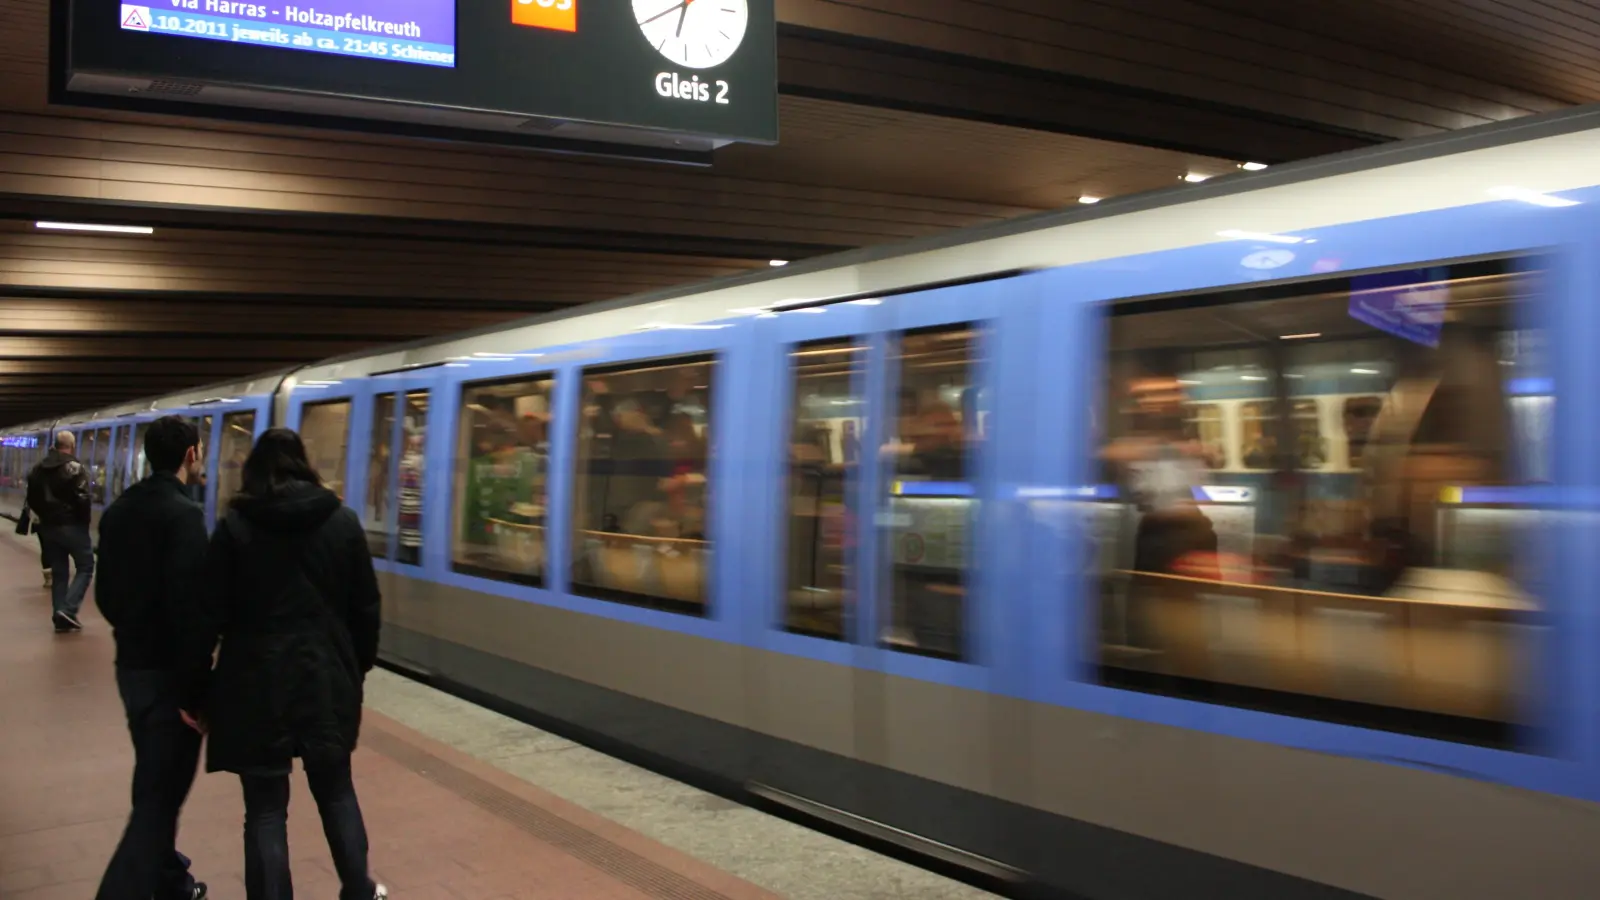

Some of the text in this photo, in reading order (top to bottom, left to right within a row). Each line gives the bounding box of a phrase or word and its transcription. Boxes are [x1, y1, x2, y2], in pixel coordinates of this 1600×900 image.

[205, 0, 267, 18] Harras
[285, 6, 421, 38] Holzapfelkreuth
[231, 24, 289, 42] jeweils
[292, 32, 313, 47] ab
[316, 37, 339, 49] ca.
[343, 38, 388, 56] 21:45
[655, 72, 729, 104] Gleis 2
